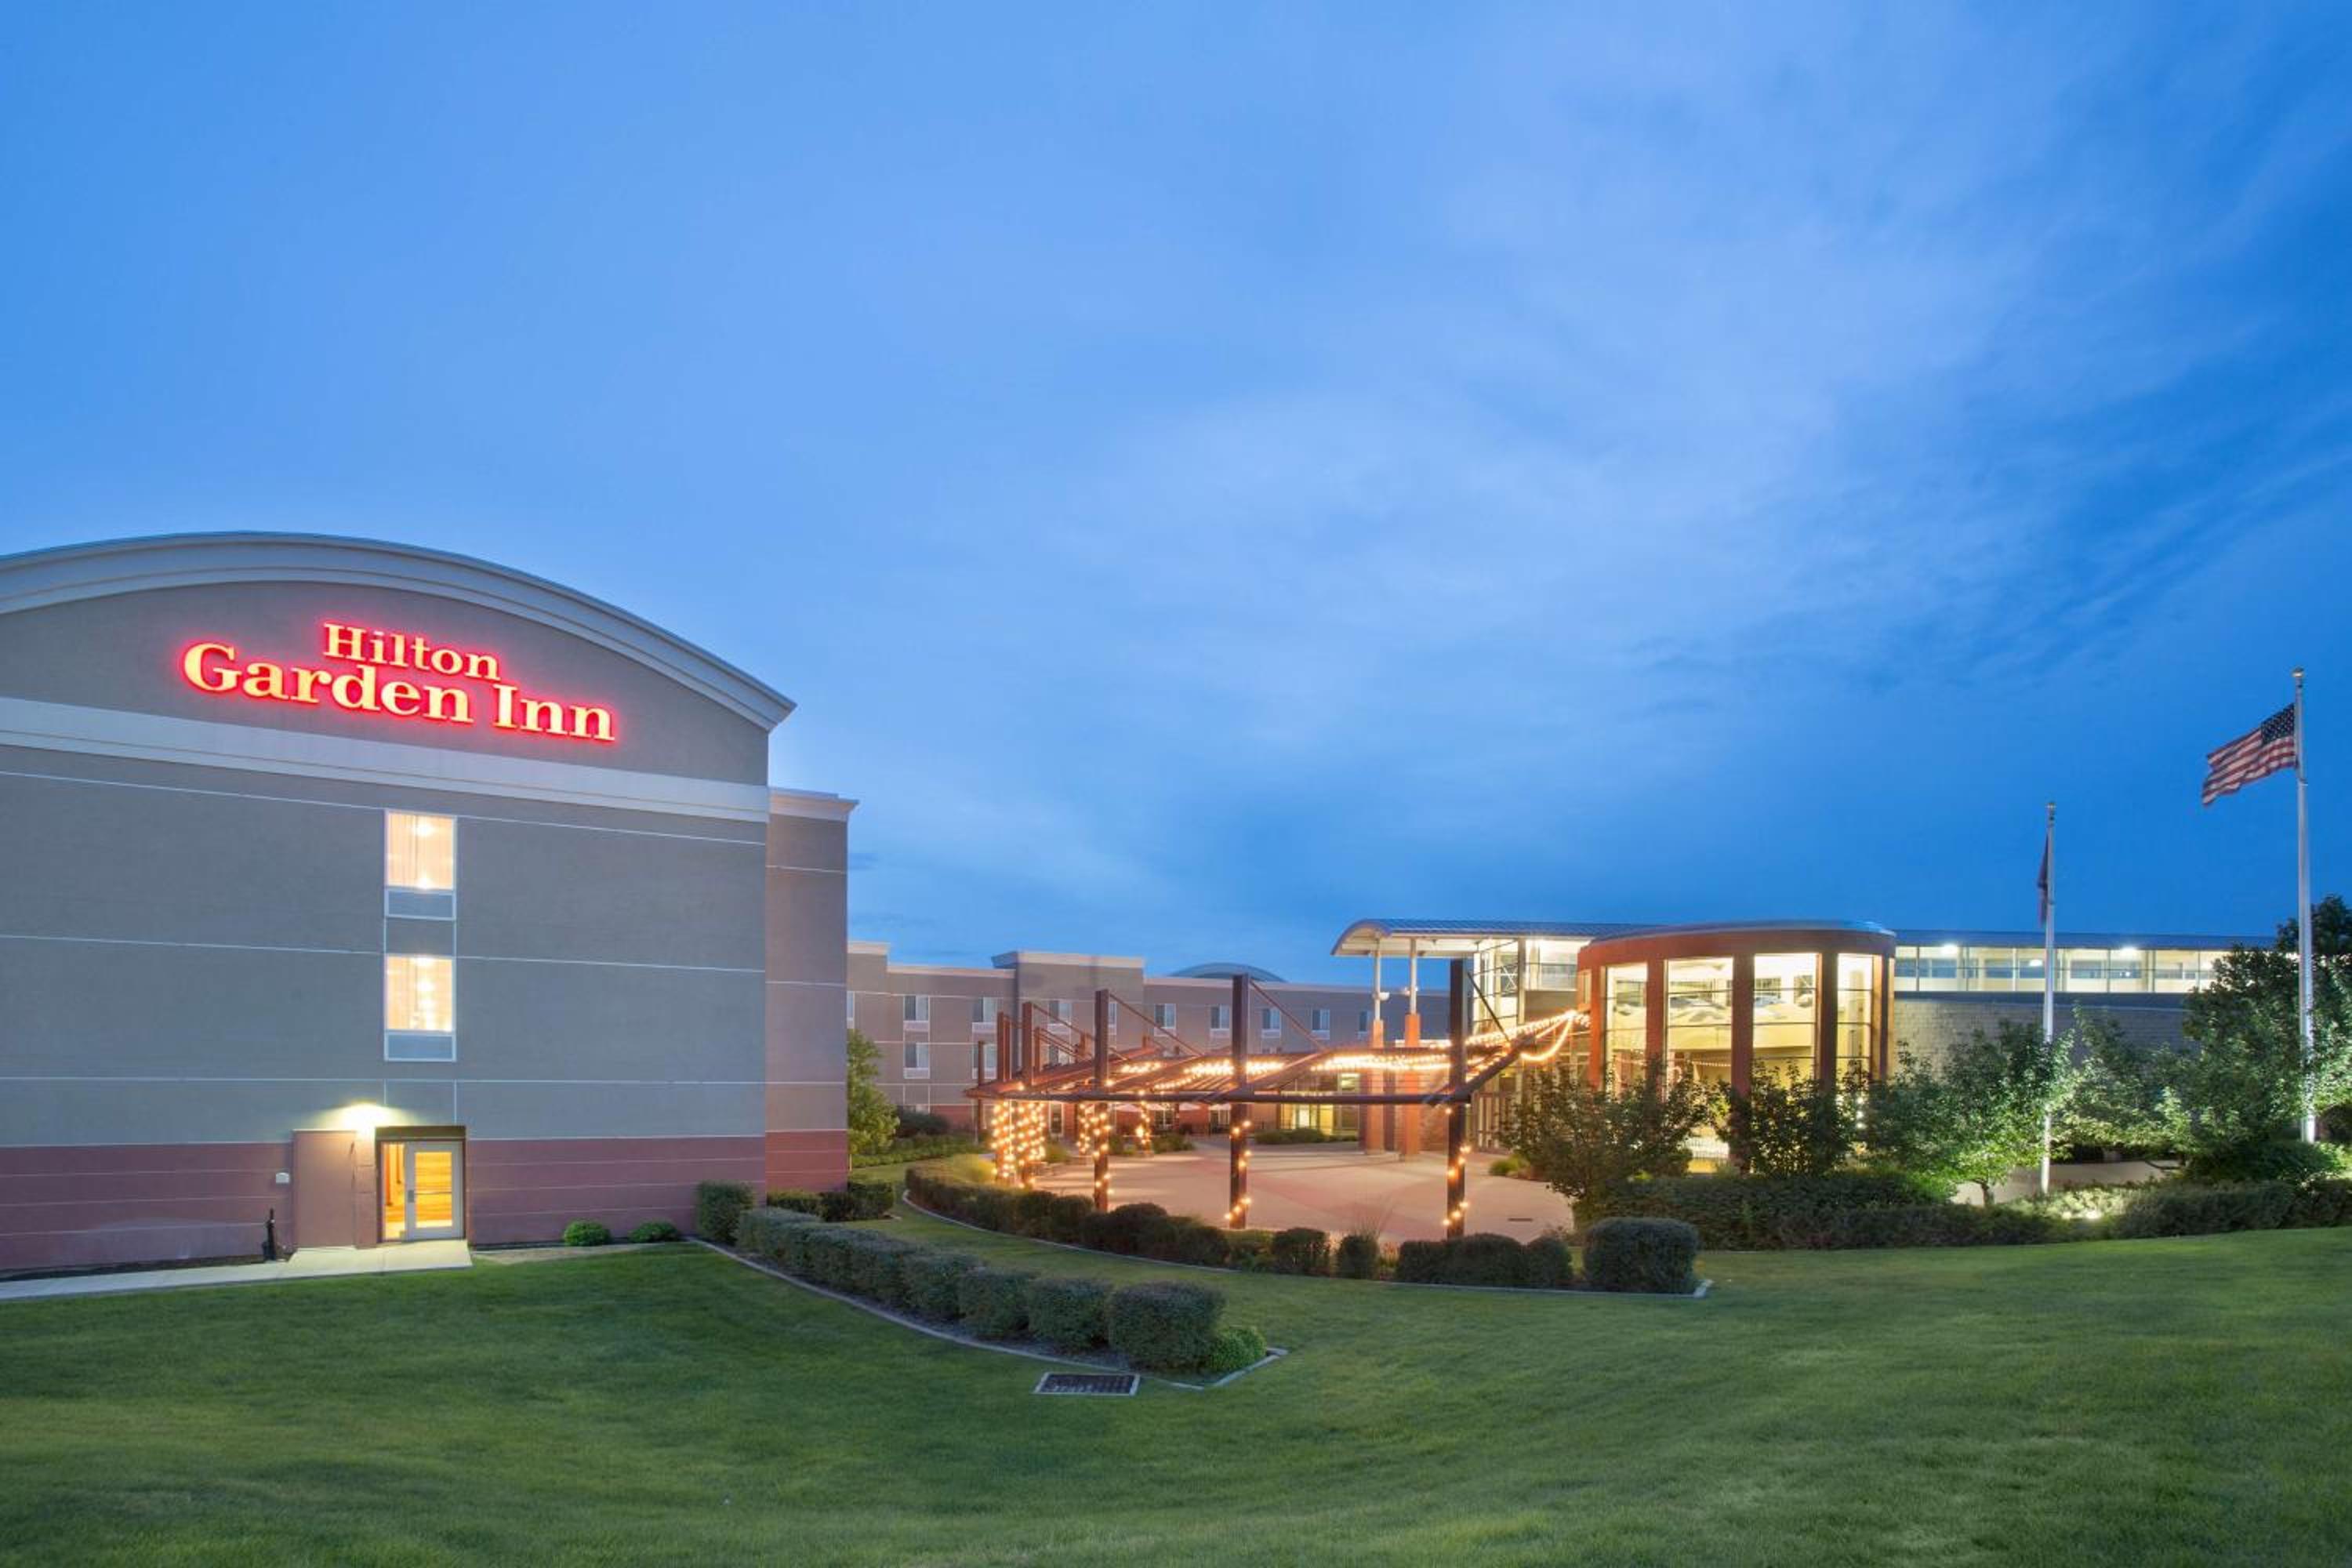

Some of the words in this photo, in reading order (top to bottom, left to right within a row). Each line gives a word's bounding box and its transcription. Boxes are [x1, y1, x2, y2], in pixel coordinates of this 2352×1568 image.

[323, 622, 501, 681] Hilton
[183, 642, 474, 724] Garden
[493, 683, 615, 741] Inn
